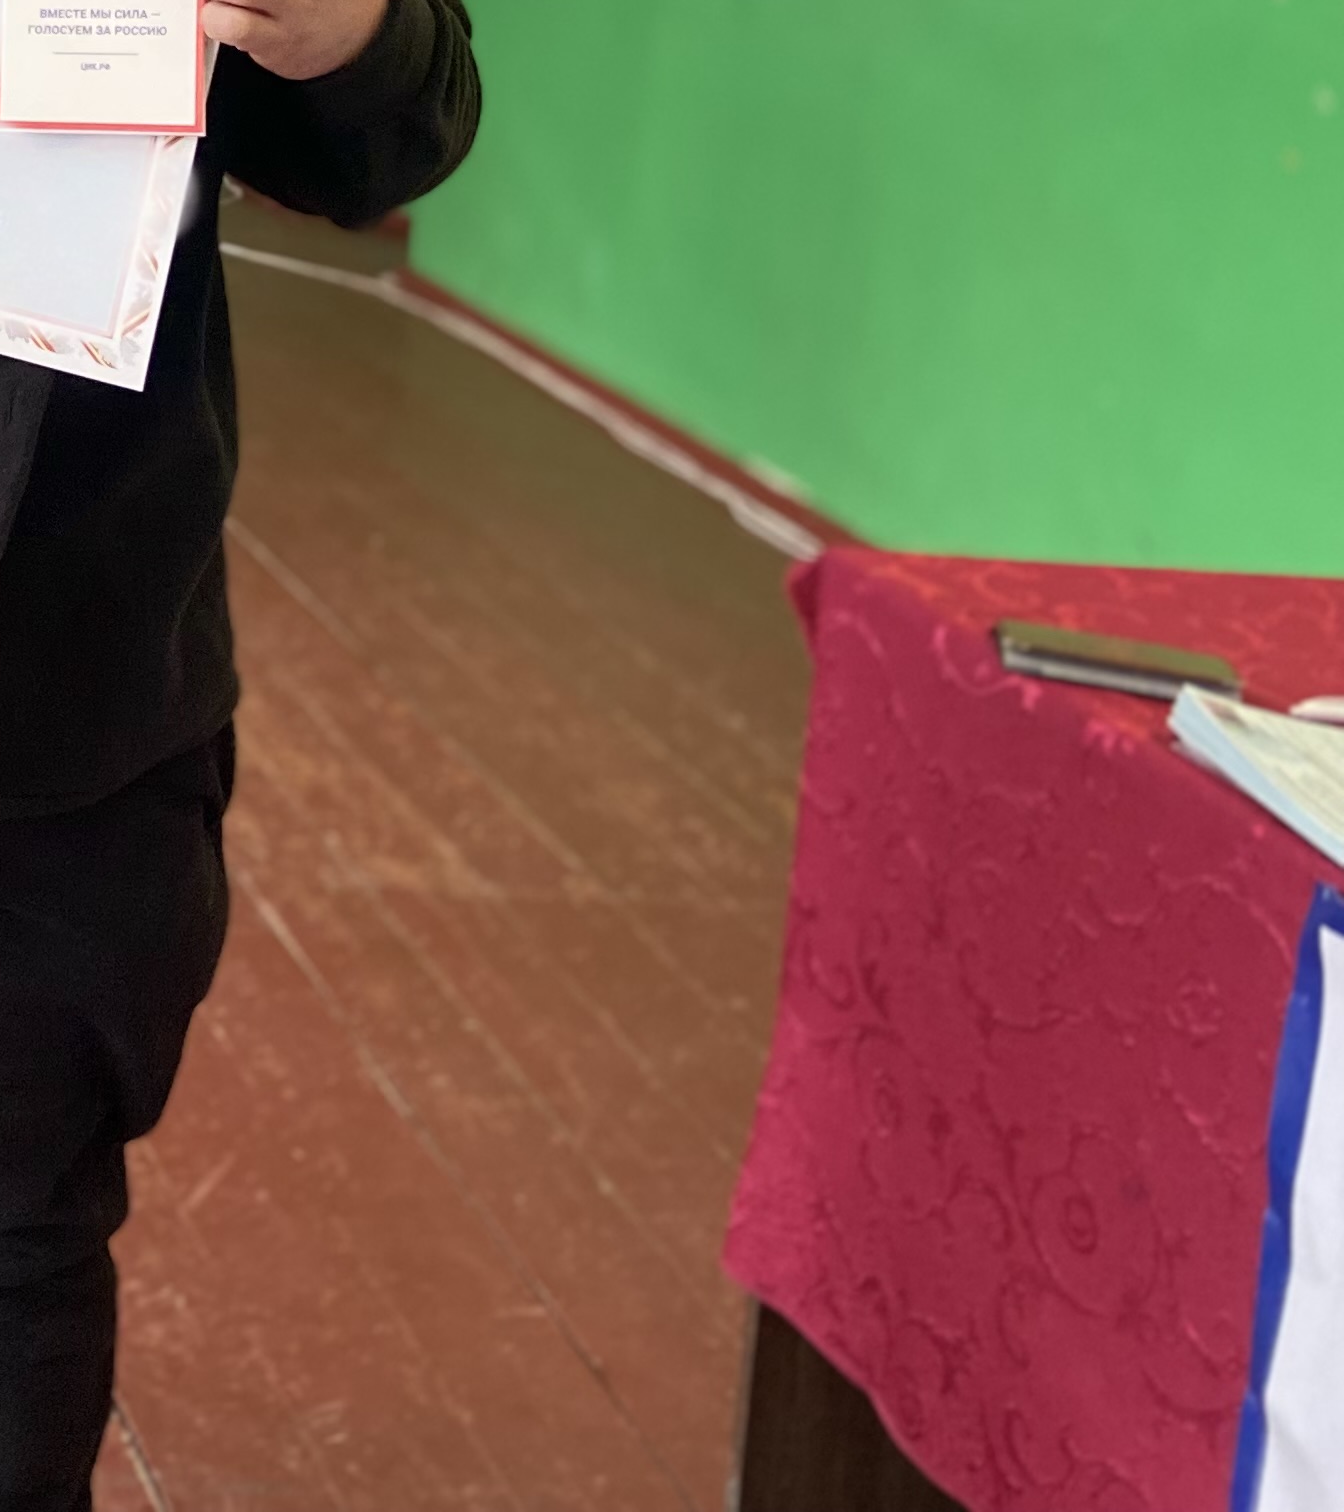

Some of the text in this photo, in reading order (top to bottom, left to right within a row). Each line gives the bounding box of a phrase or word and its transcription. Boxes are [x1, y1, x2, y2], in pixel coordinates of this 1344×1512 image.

[39, 8, 87, 19] ВМЕСТЕ
[90, 8, 112, 19] МЫ
[114, 9, 148, 20] СИЛА
[27, 24, 168, 36] ГОЛОСУЕМ ЗА РОССИЮ
